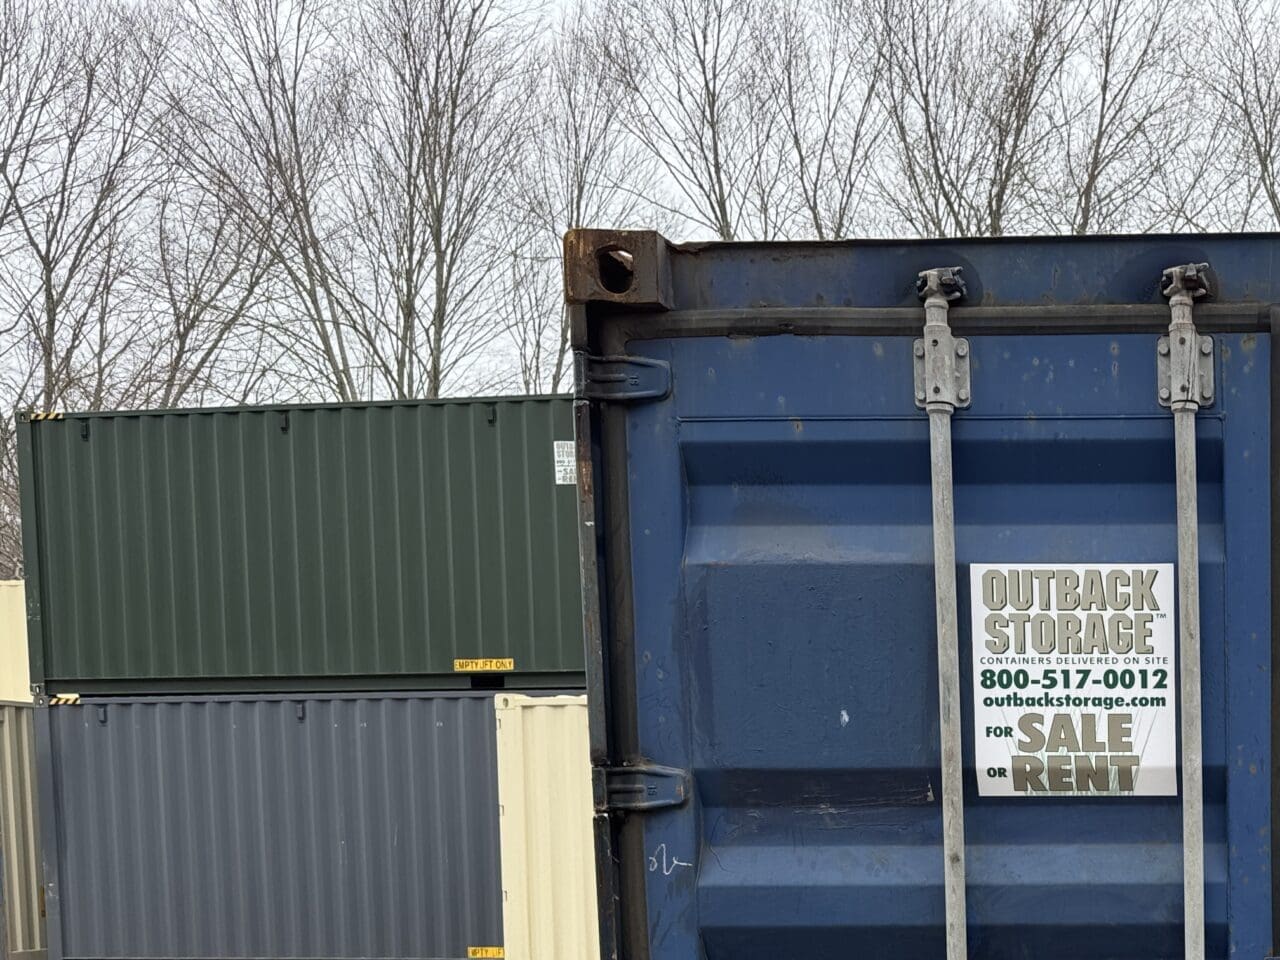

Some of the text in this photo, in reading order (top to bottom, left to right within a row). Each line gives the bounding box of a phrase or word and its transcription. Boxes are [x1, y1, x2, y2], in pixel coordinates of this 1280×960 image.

[981, 569, 1160, 612] OUTBACK
[979, 656, 1169, 665] CONTAINERS DELIVERED ON SITE
[980, 669, 1168, 690] 800-517-0012
[983, 692, 1166, 711] outbackstorage.com
[985, 712, 1133, 753] FOR SALE
[987, 755, 1140, 792] OR RENT
